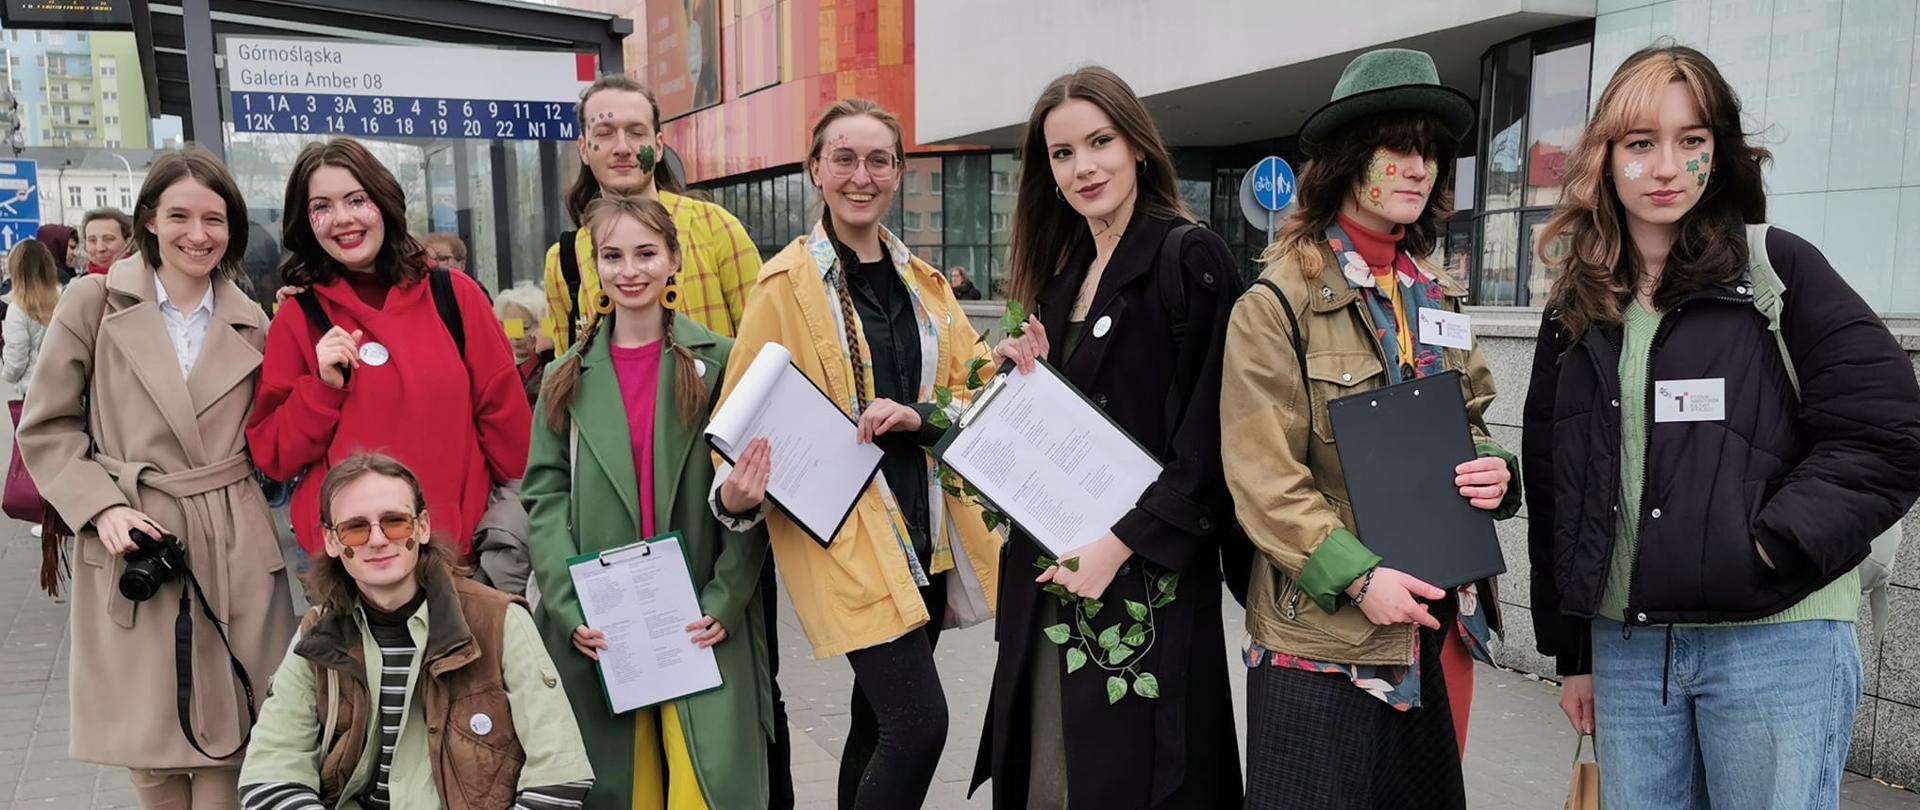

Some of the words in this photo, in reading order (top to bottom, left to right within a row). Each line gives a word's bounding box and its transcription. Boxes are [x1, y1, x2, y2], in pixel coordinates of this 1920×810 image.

[239, 44, 342, 66] Górnośląska
[241, 69, 298, 86] Galeria
[305, 72, 357, 88] Amber
[363, 74, 383, 89] 08
[243, 95, 251, 110] 1
[268, 95, 290, 111] 1A
[307, 96, 317, 112] 3
[335, 97, 357, 113] 3A
[373, 98, 394, 114] 3B
[411, 100, 421, 115] 4
[439, 101, 448, 116] 5
[464, 102, 473, 116] 6
[489, 103, 498, 117] 9
[514, 104, 530, 118] 11
[545, 105, 561, 119] 12
[245, 114, 275, 130] 12K
[292, 115, 310, 131] 13
[327, 117, 345, 131] 14
[361, 118, 379, 133] 16
[396, 118, 414, 134] 18
[431, 119, 448, 134] 19
[464, 120, 482, 135] 20
[497, 121, 514, 136] 22
[529, 123, 546, 136] N1
[561, 123, 573, 137] M
